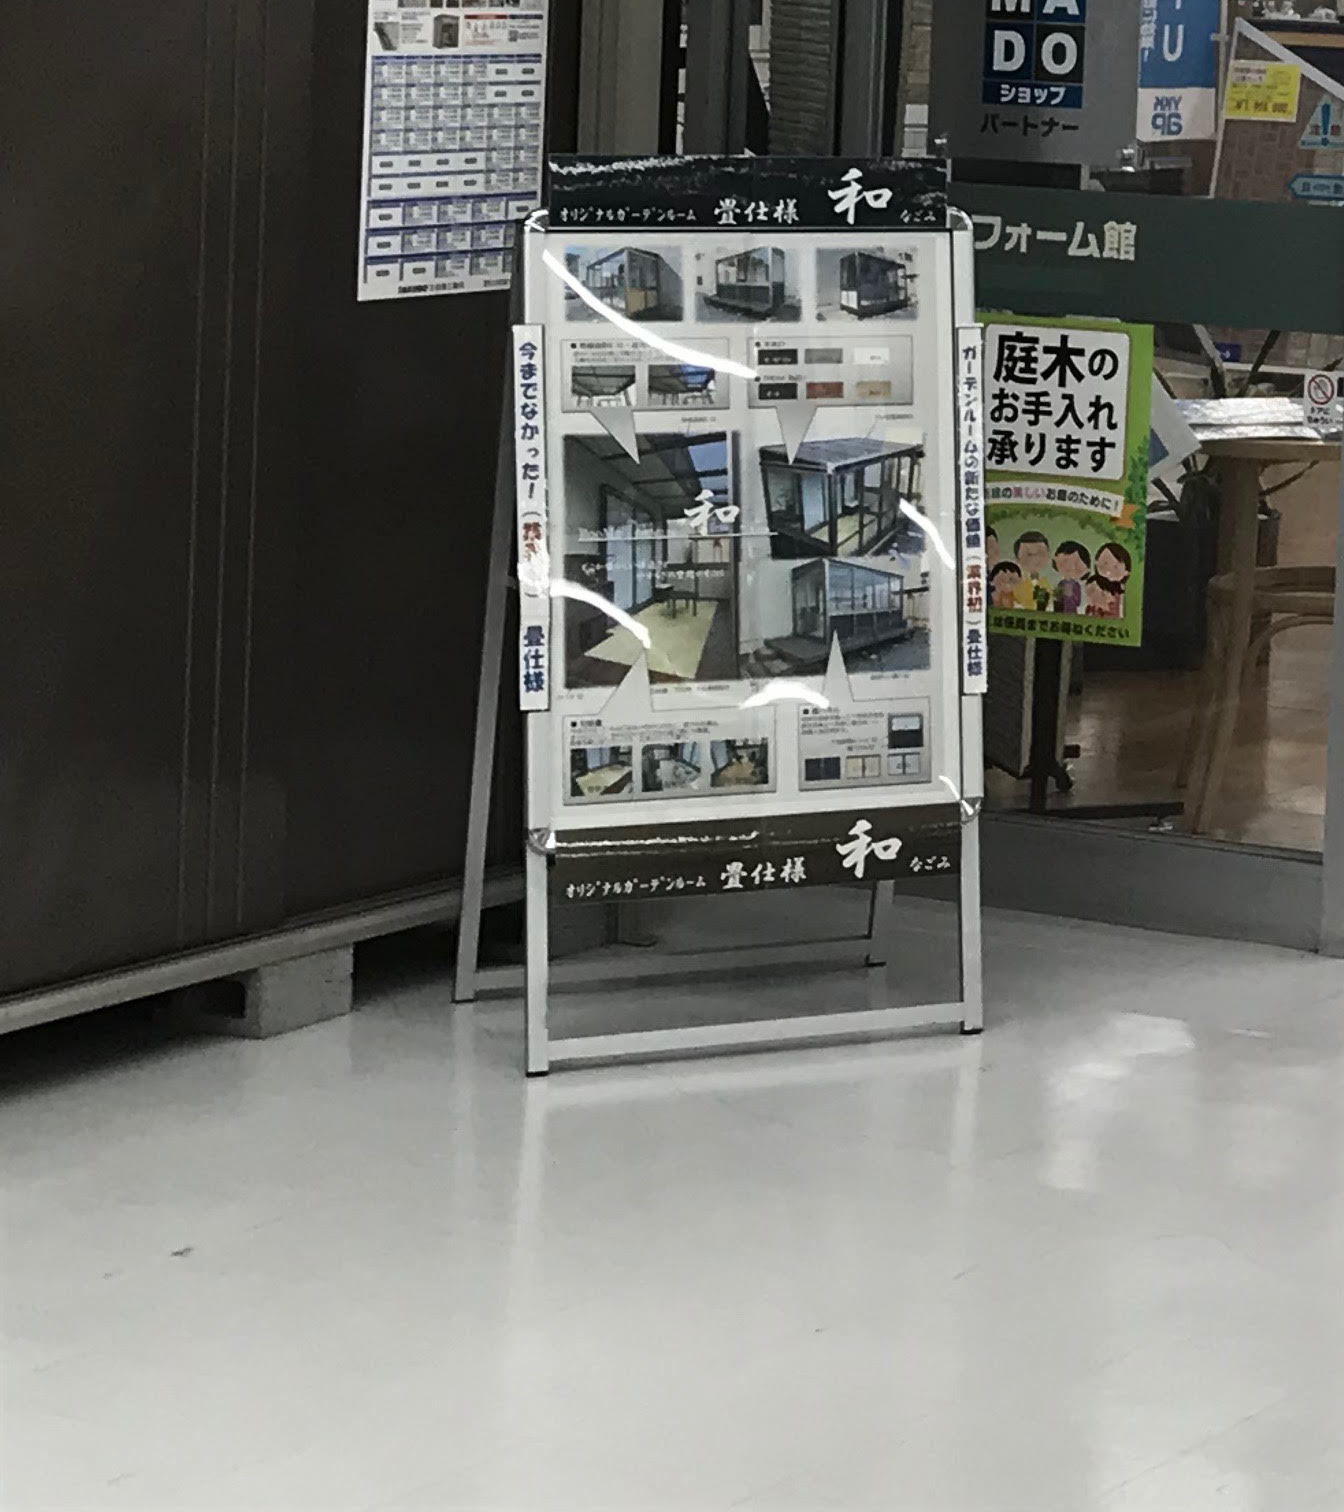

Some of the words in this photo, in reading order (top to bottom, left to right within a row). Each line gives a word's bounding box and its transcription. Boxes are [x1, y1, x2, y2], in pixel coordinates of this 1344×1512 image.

[999, 84, 1067, 105] ショップ
[979, 114, 1081, 136] パートナー
[713, 198, 800, 226] 畳仕様
[826, 167, 894, 226] 和
[972, 214, 1138, 262] フォーム館
[992, 329, 1119, 389] 庭木の
[988, 390, 1119, 432] お手入れ
[986, 431, 1117, 474] 承ります
[683, 488, 742, 537] 和
[720, 856, 808, 890] 畳仕様
[835, 818, 903, 879] 和
